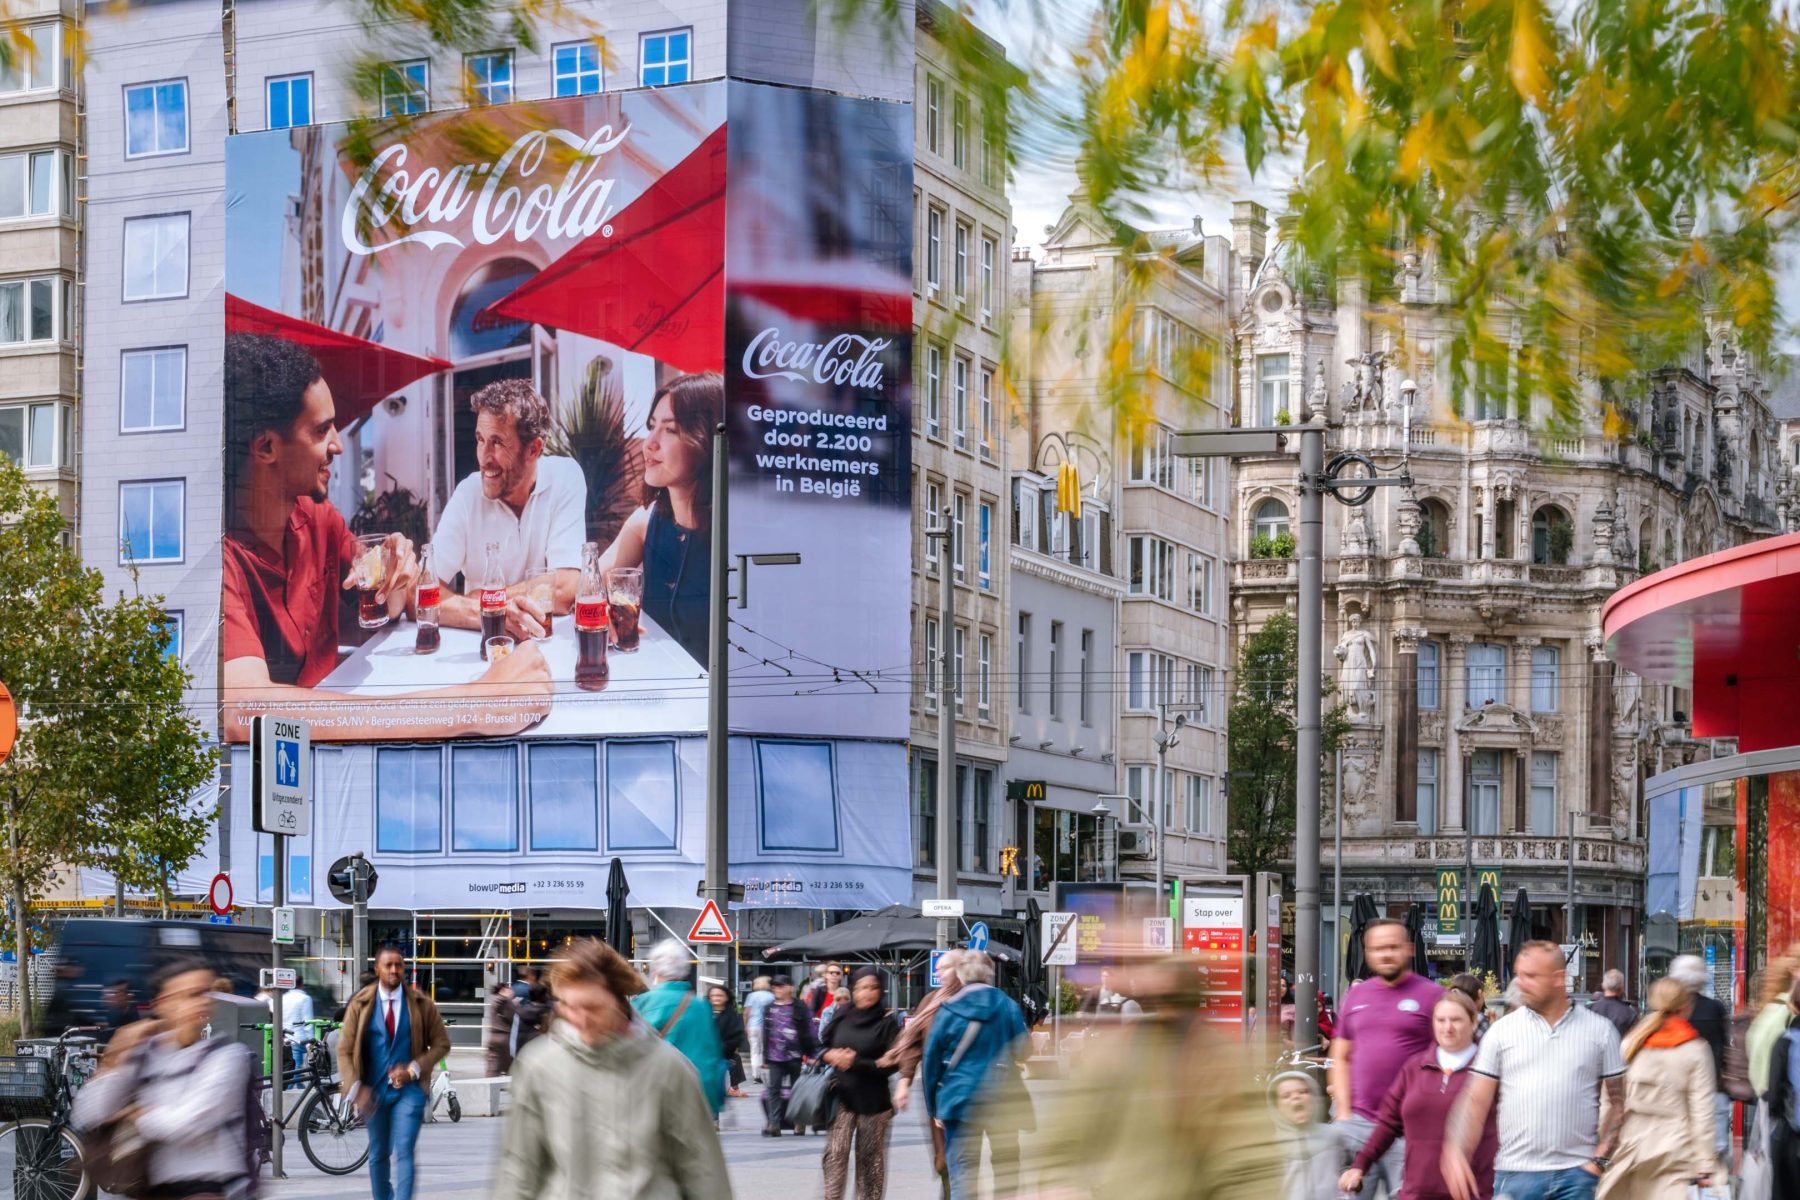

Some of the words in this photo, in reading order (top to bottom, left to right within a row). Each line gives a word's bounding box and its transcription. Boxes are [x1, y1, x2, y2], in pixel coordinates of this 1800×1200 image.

[742, 327, 892, 390] Coca-Cola
[747, 405, 887, 431] Geproduceerd
[764, 429, 811, 447] door
[816, 432, 872, 452] 2.200
[756, 453, 879, 475] werknemers
[776, 475, 794, 492] in
[800, 477, 861, 498] België
[336, 716, 363, 727] SA/NV
[371, 715, 454, 729] Bergensesteenweg
[456, 714, 478, 724] 1424
[485, 712, 516, 724] Brussel
[519, 712, 541, 723] 1070
[275, 722, 300, 739] ZONE
[272, 791, 303, 805] Uitgezonderd
[533, 880, 544, 888] +32
[547, 880, 551, 888] 3
[553, 880, 564, 888] 236
[566, 880, 575, 888] 55
[855, 882, 864, 890] 59
[1215, 909, 1232, 917] over
